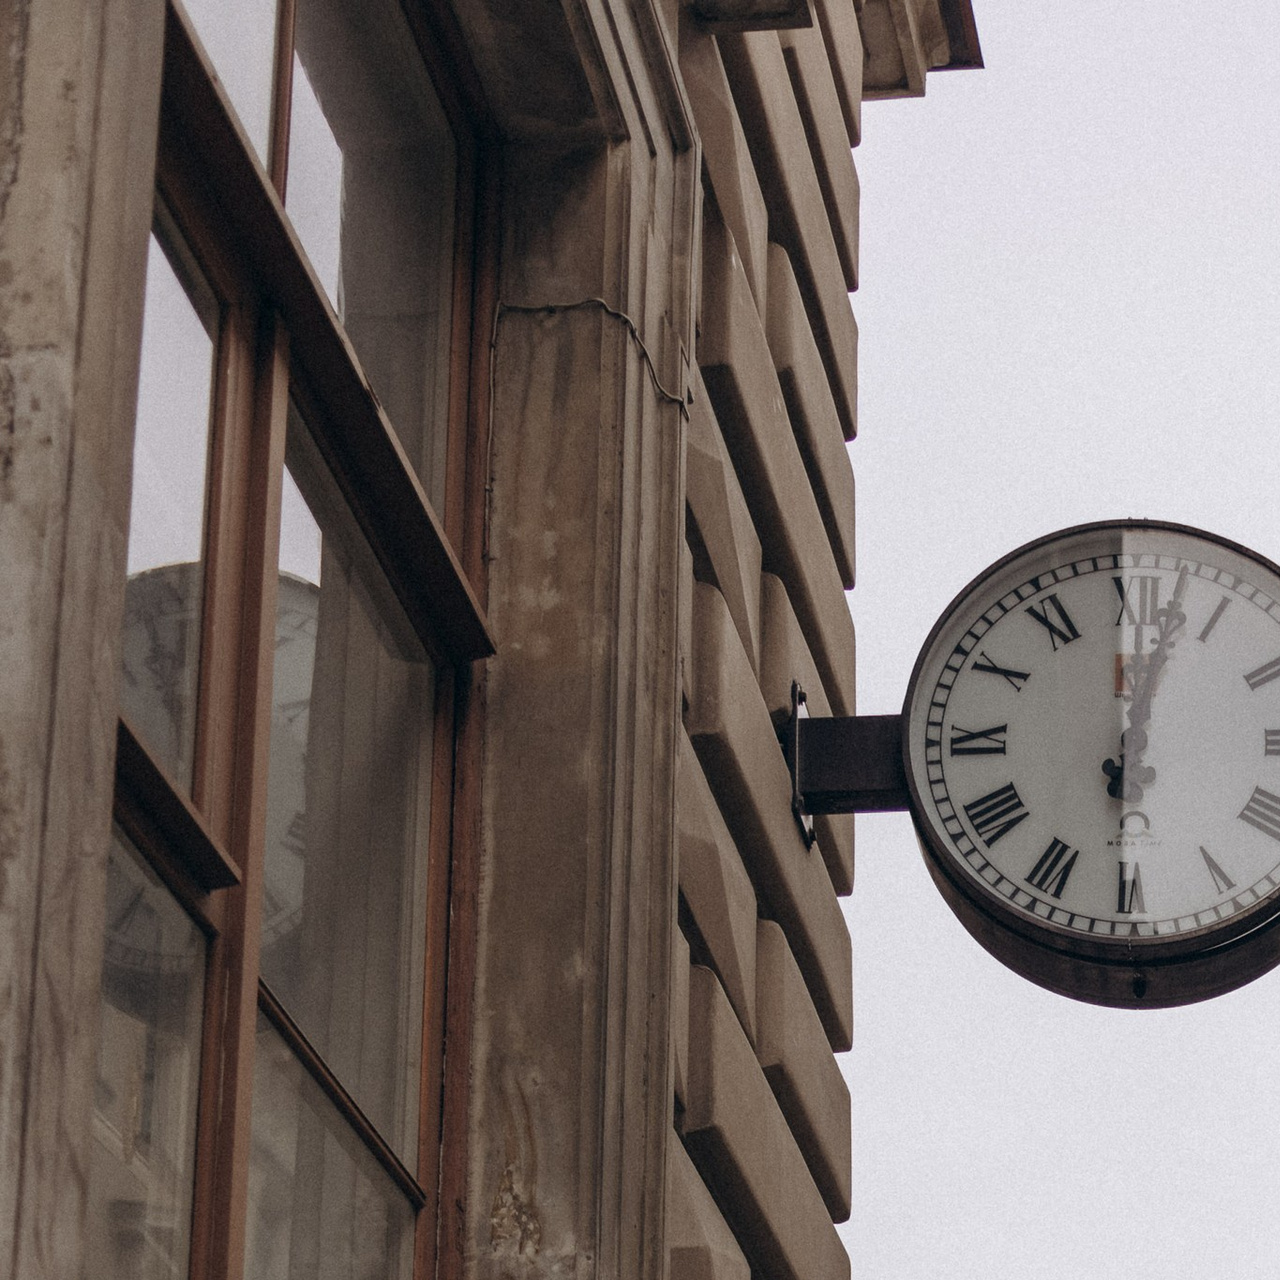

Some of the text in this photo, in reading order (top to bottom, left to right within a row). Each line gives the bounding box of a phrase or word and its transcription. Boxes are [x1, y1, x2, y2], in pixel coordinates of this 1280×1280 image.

[1025, 593, 1081, 651] XI
[1112, 576, 1161, 625] XII
[1197, 596, 1232, 642] I
[971, 651, 1030, 692] X
[951, 723, 1007, 756] IX
[963, 782, 1029, 848] VIII
[1025, 837, 1079, 899] VII
[1116, 861, 1147, 913] VI
[1199, 845, 1237, 894] V
